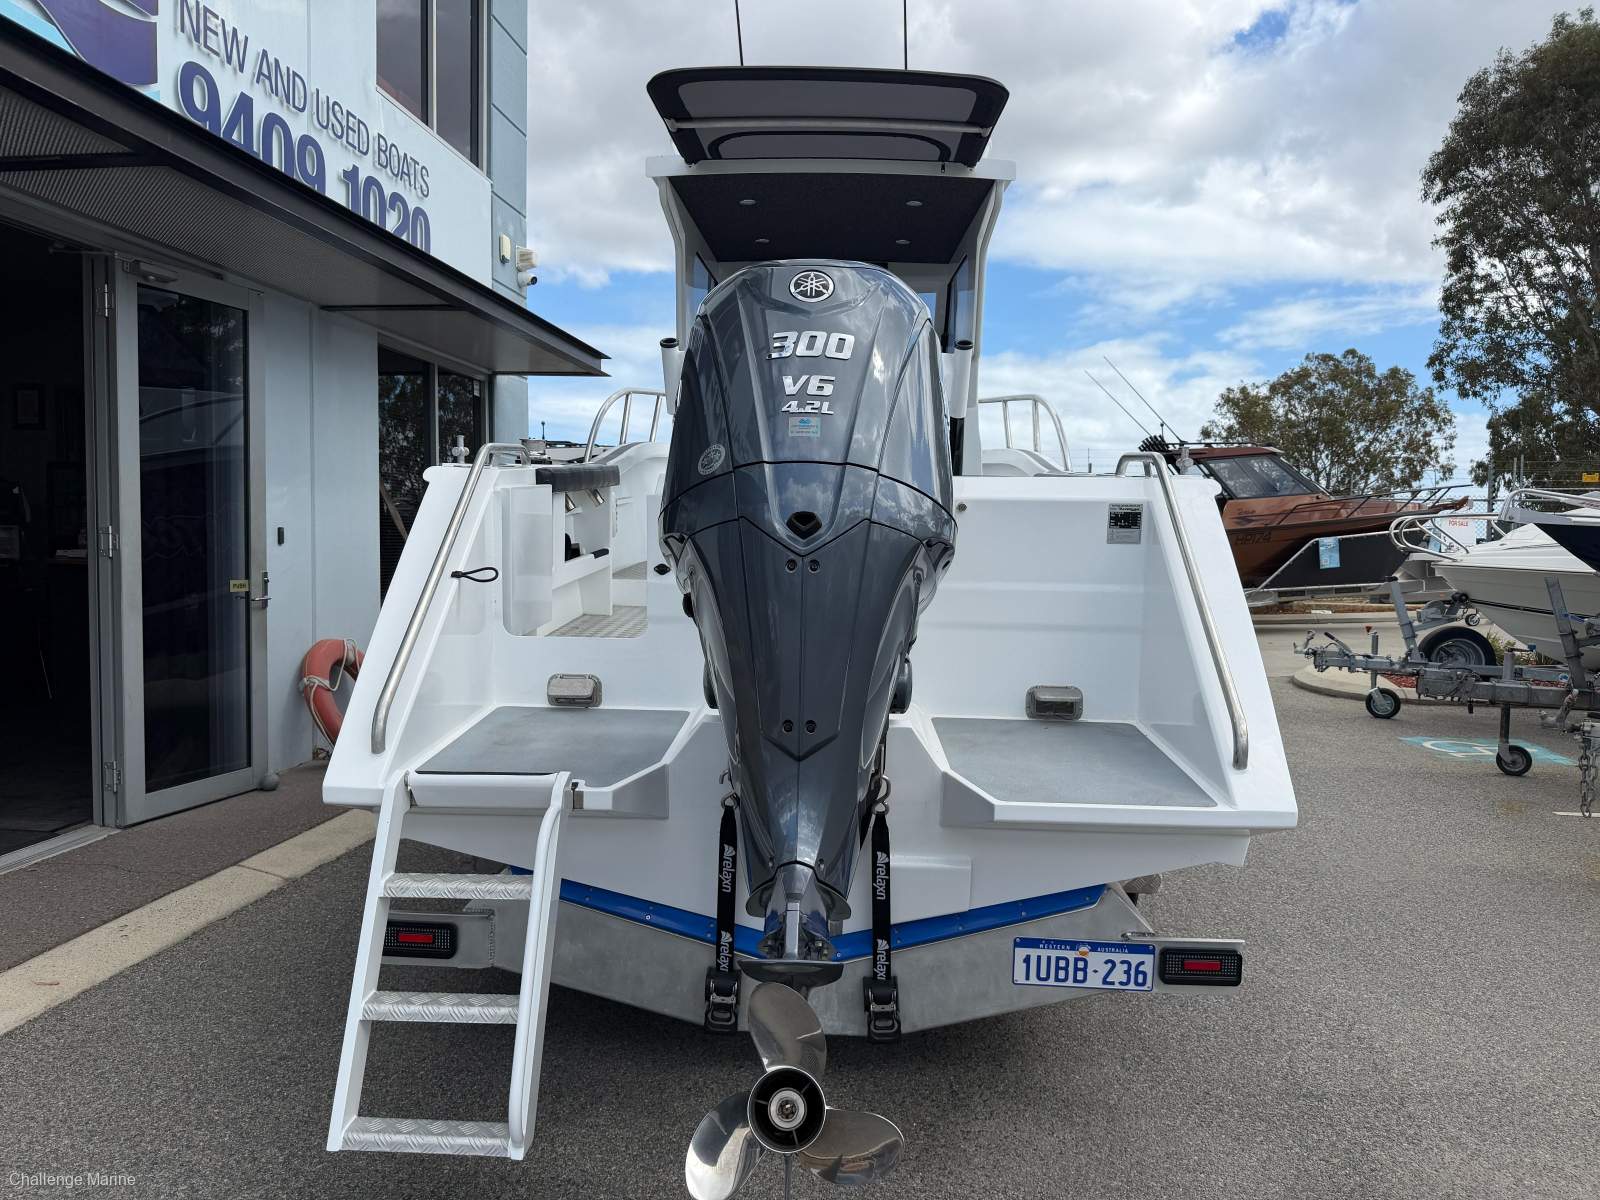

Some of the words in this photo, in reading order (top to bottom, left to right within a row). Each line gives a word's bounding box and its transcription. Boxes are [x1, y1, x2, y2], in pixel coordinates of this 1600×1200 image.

[179, 0, 249, 73] NEW
[256, 48, 307, 113] AND
[315, 88, 370, 156] USED
[377, 132, 430, 198] BOATS
[179, 61, 327, 196] 9409
[342, 163, 431, 256] 1020
[766, 330, 855, 360] 300
[782, 375, 836, 396] V6
[781, 400, 835, 415] 4.2L
[1448, 519, 1457, 527] FOR
[1458, 519, 1469, 527] SALE
[719, 856, 735, 893] relaxn
[873, 863, 889, 901] relaxn
